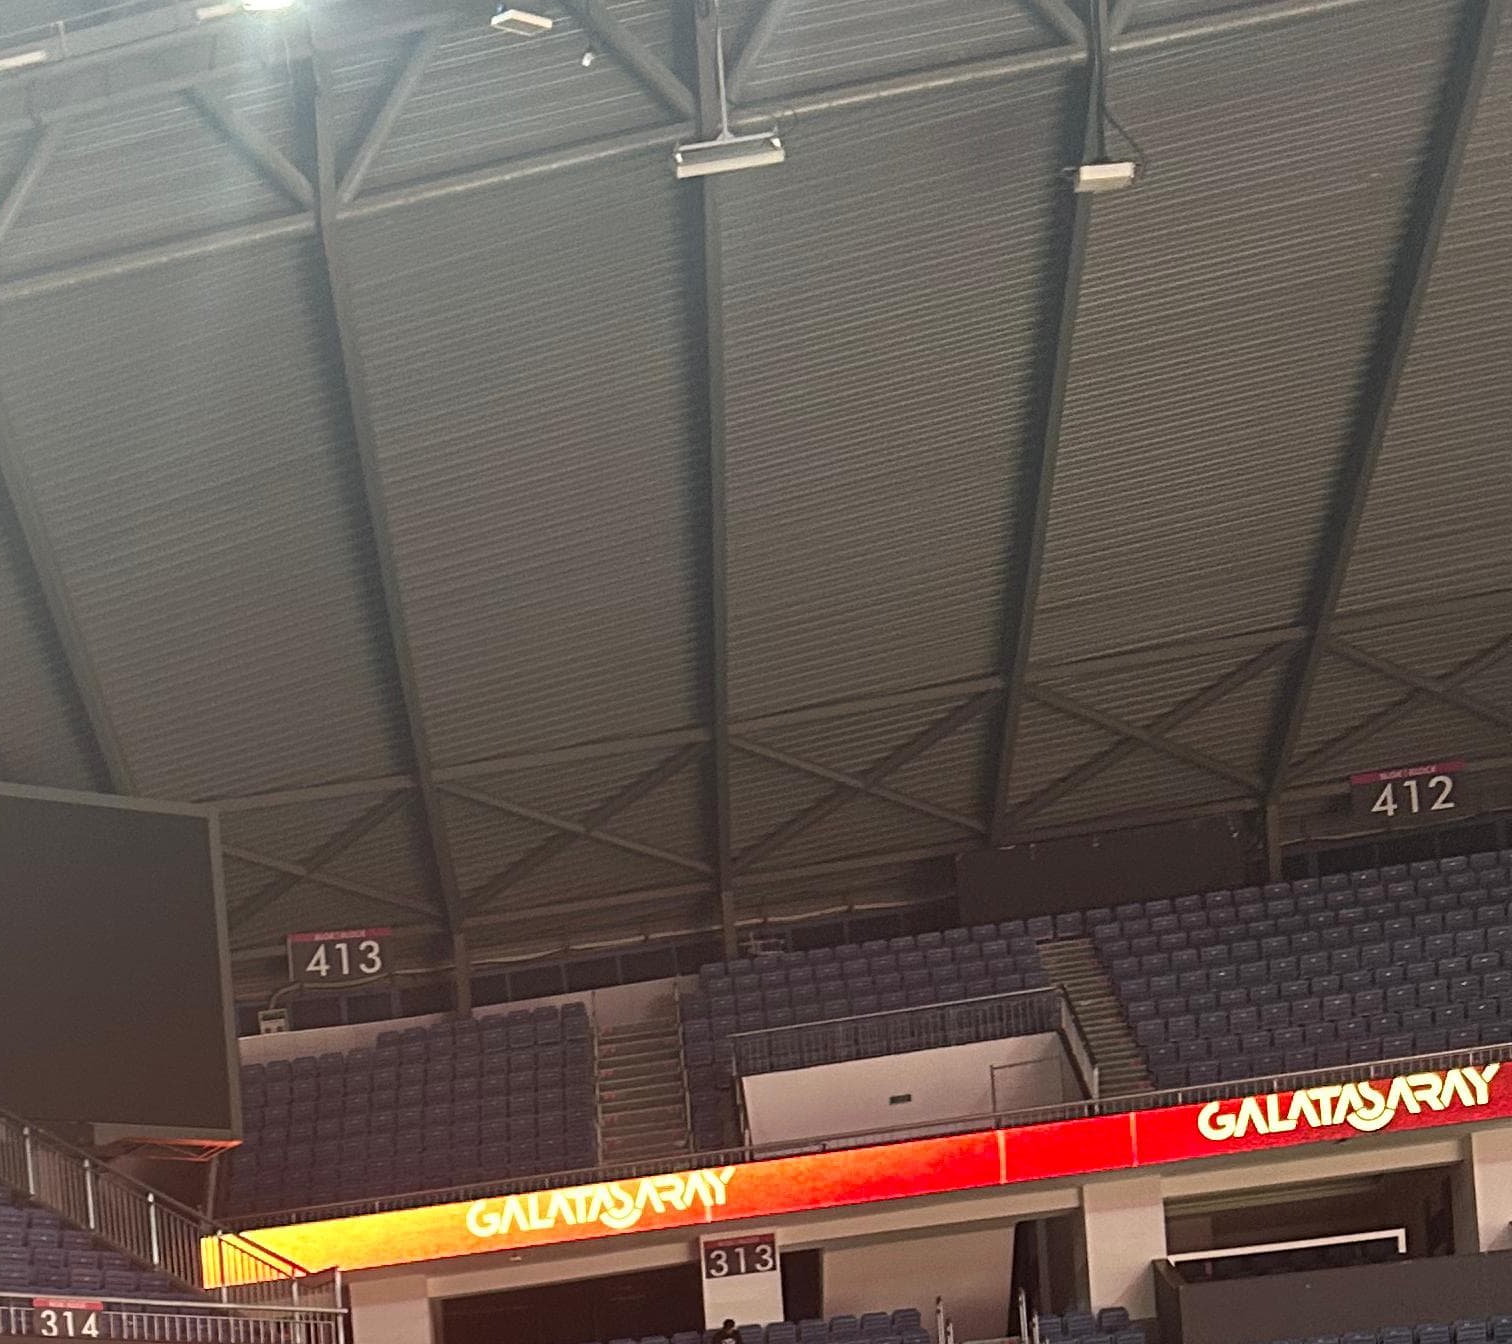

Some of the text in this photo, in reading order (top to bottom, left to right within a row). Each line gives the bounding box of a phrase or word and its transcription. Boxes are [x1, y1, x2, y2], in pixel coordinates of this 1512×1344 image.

[1371, 775, 1456, 816] 412
[306, 940, 383, 976] 413
[1197, 1062, 1500, 1141] GALATASARAY
[465, 1165, 737, 1238] GALATASARAY
[710, 1244, 775, 1277] 313
[40, 1309, 100, 1338] 314
